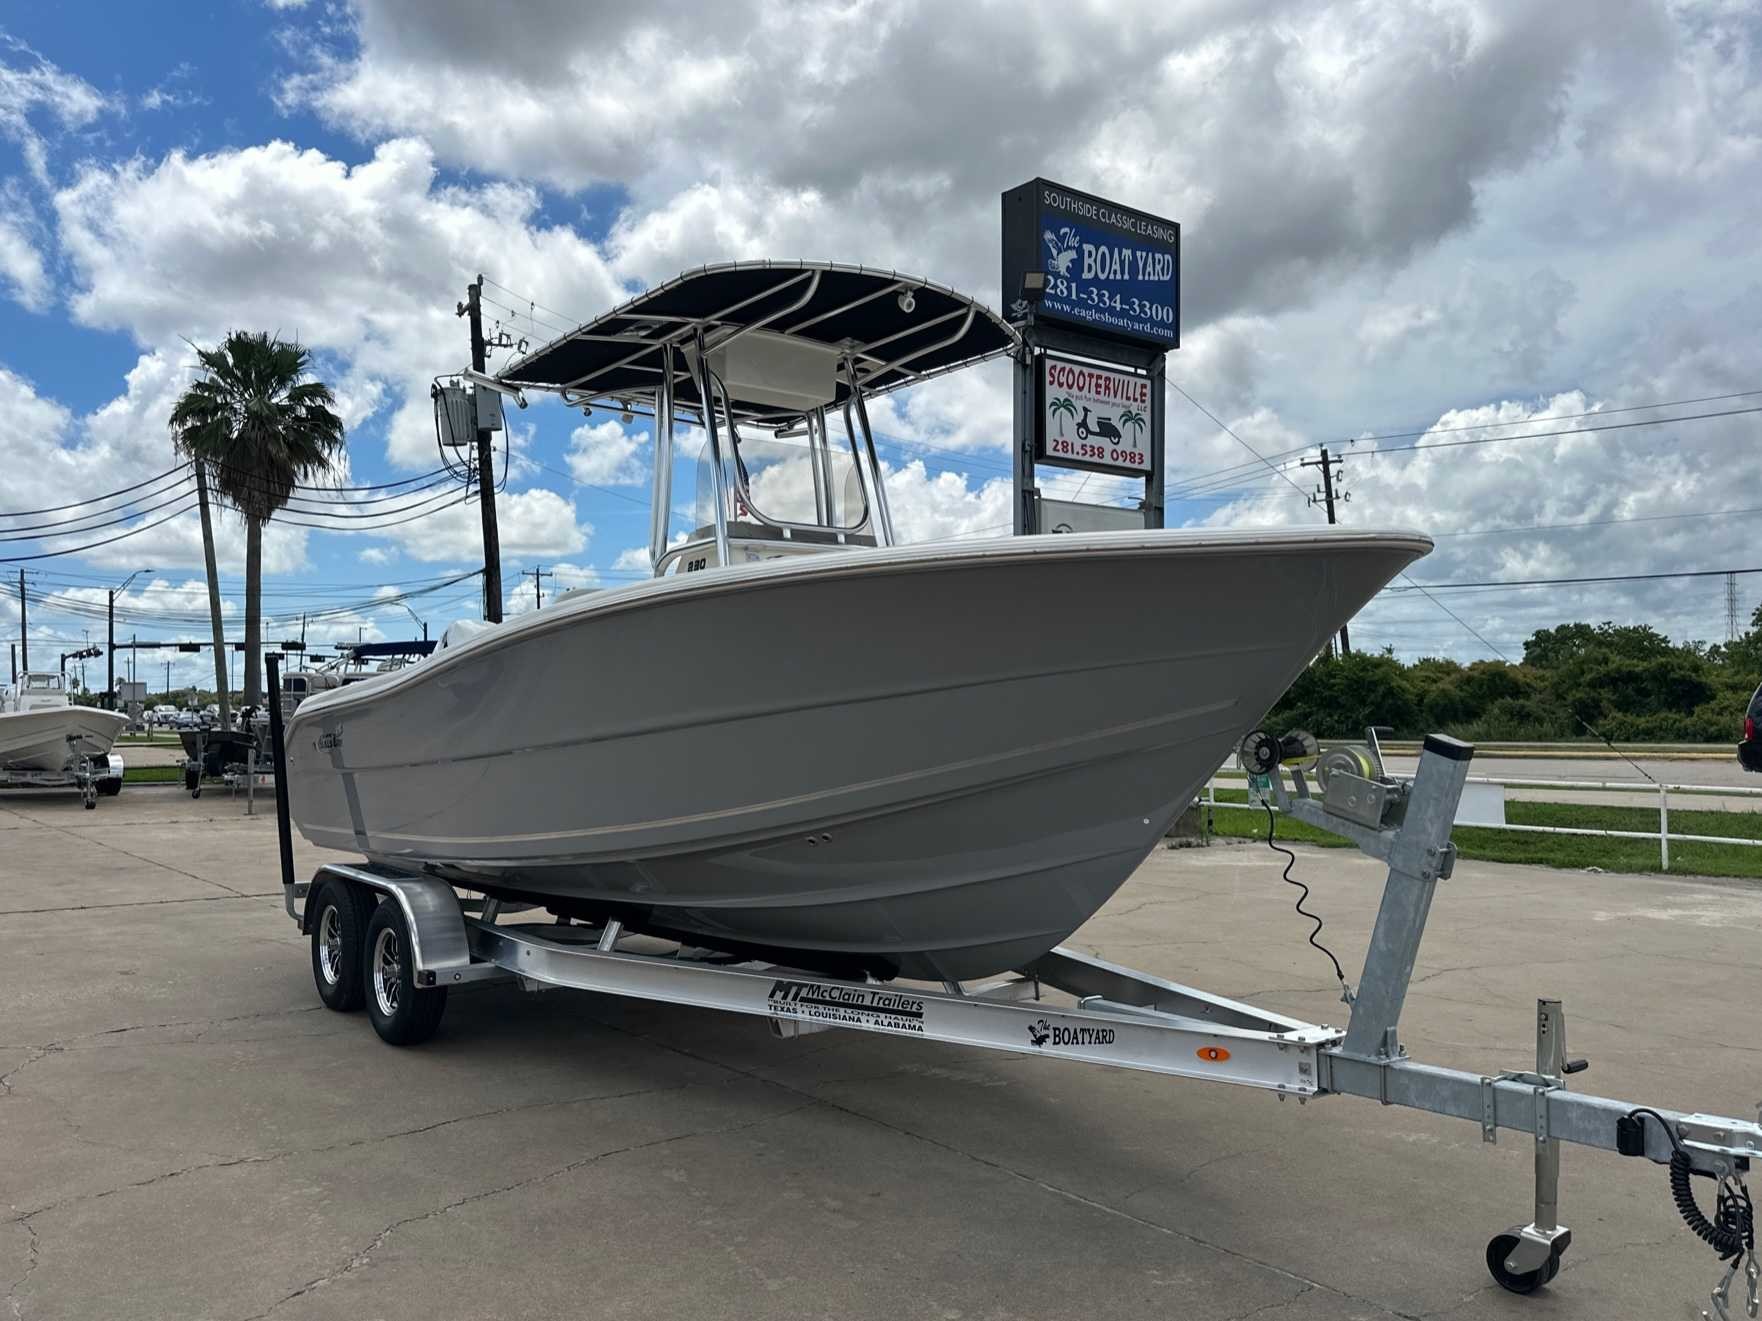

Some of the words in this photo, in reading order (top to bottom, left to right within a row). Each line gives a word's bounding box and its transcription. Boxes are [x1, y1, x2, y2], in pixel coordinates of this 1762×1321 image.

[1044, 191, 1097, 219] SOUTHSIDE
[1099, 208, 1136, 232] CLASSIC
[1137, 221, 1175, 243] LEASING
[1060, 227, 1080, 248] The
[1082, 243, 1132, 280] BOAT
[1136, 250, 1173, 281] YARD
[1045, 275, 1173, 324] 281-334-3300
[1044, 299, 1174, 338] www.eaglesboatyard.com
[1048, 364, 1147, 403] SCOOTERVILLE
[1052, 439, 1104, 460] 281.538
[1111, 448, 1144, 465] 0983
[806, 984, 865, 1003] McClain
[869, 991, 924, 1011] Trailers
[768, 1004, 798, 1014] TEXAS
[809, 1010, 862, 1023] LOUISIANA
[874, 1020, 924, 1032] ALABAMA
[1038, 1017, 1050, 1031] The
[1052, 1027, 1115, 1045] BOATYARD
